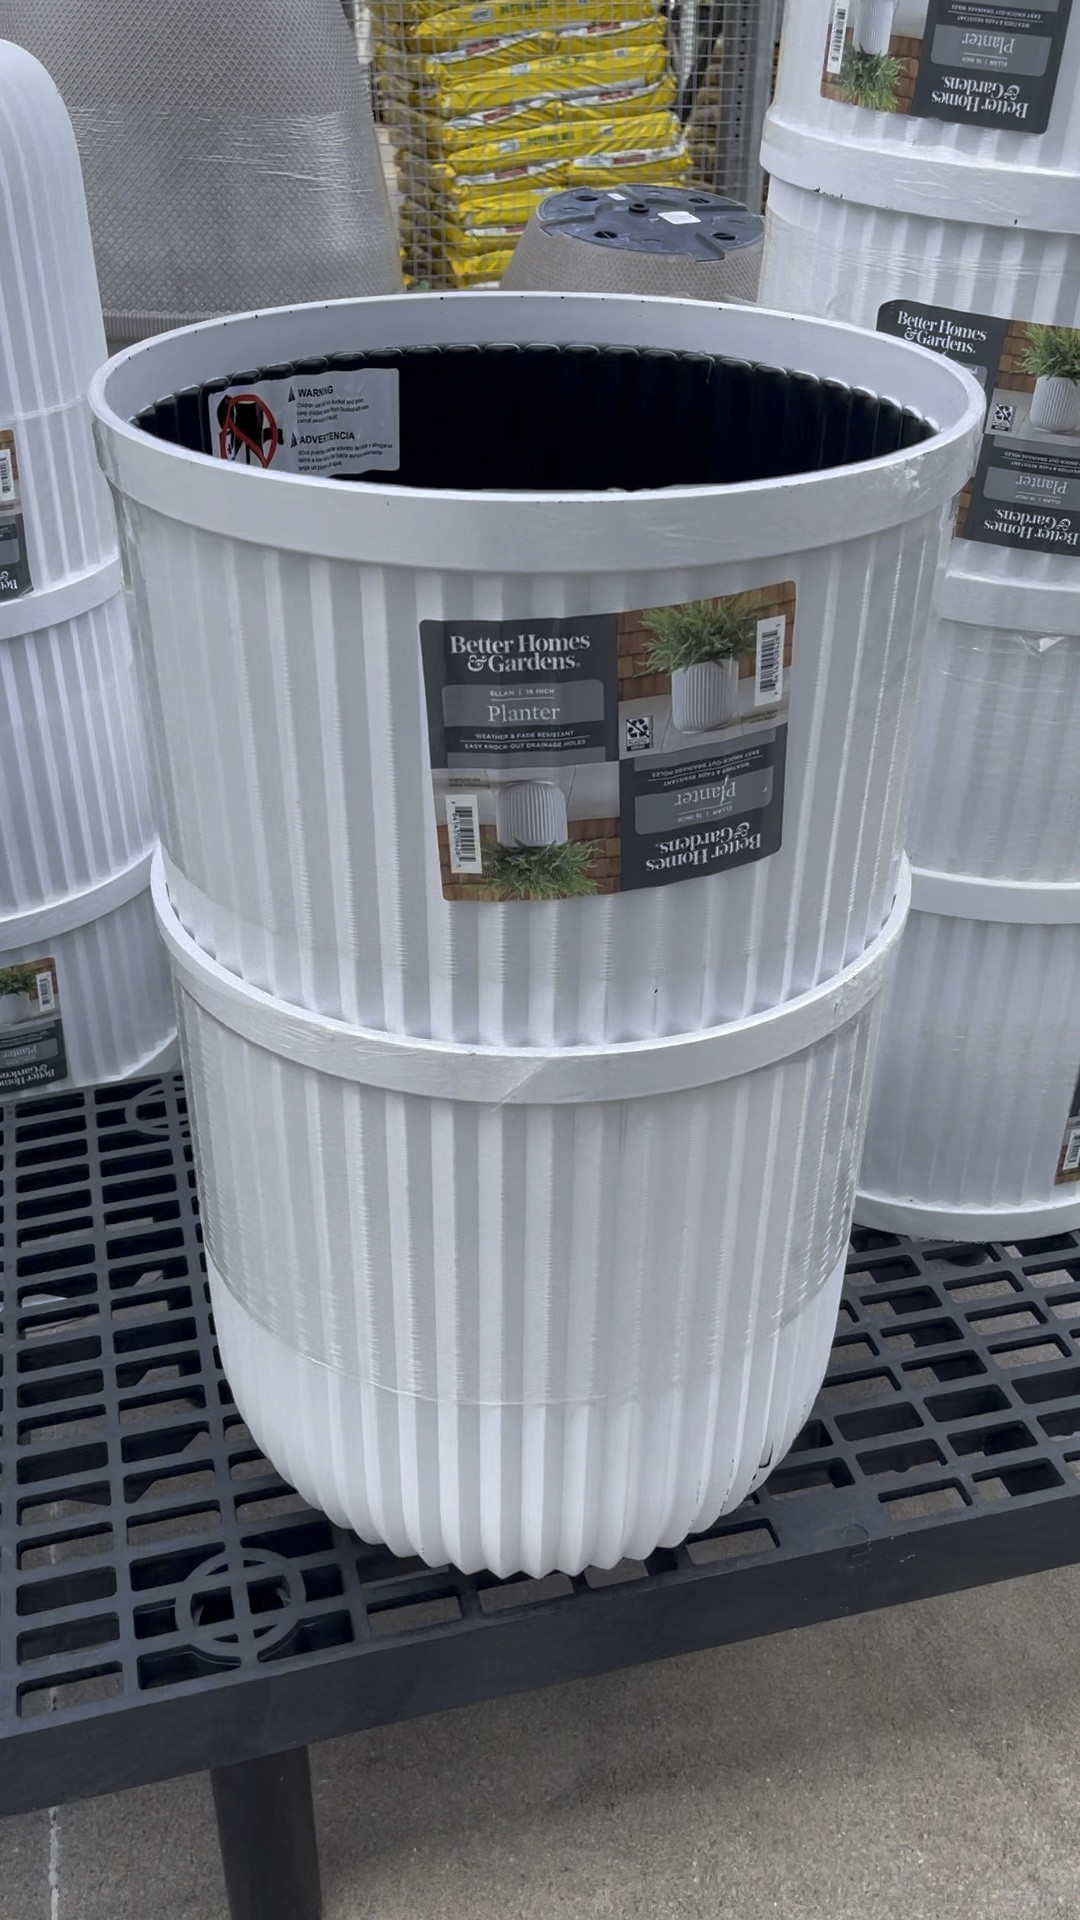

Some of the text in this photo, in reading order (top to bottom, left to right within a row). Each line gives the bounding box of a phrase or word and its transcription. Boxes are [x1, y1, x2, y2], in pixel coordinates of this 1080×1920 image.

[961, 33, 1016, 54] Planter
[931, 90, 1029, 118] Better Homes
[897, 310, 988, 342] Better Homes
[1015, 475, 1068, 495] Planter
[983, 519, 1080, 545] Better Homes
[450, 633, 591, 654] Better Homes
[487, 704, 561, 723] Planter
[536, 730, 574, 738] RESISTANT
[674, 781, 737, 807] Planter
[645, 832, 762, 872] Better Homes
[26, 1068, 55, 1082] Better
